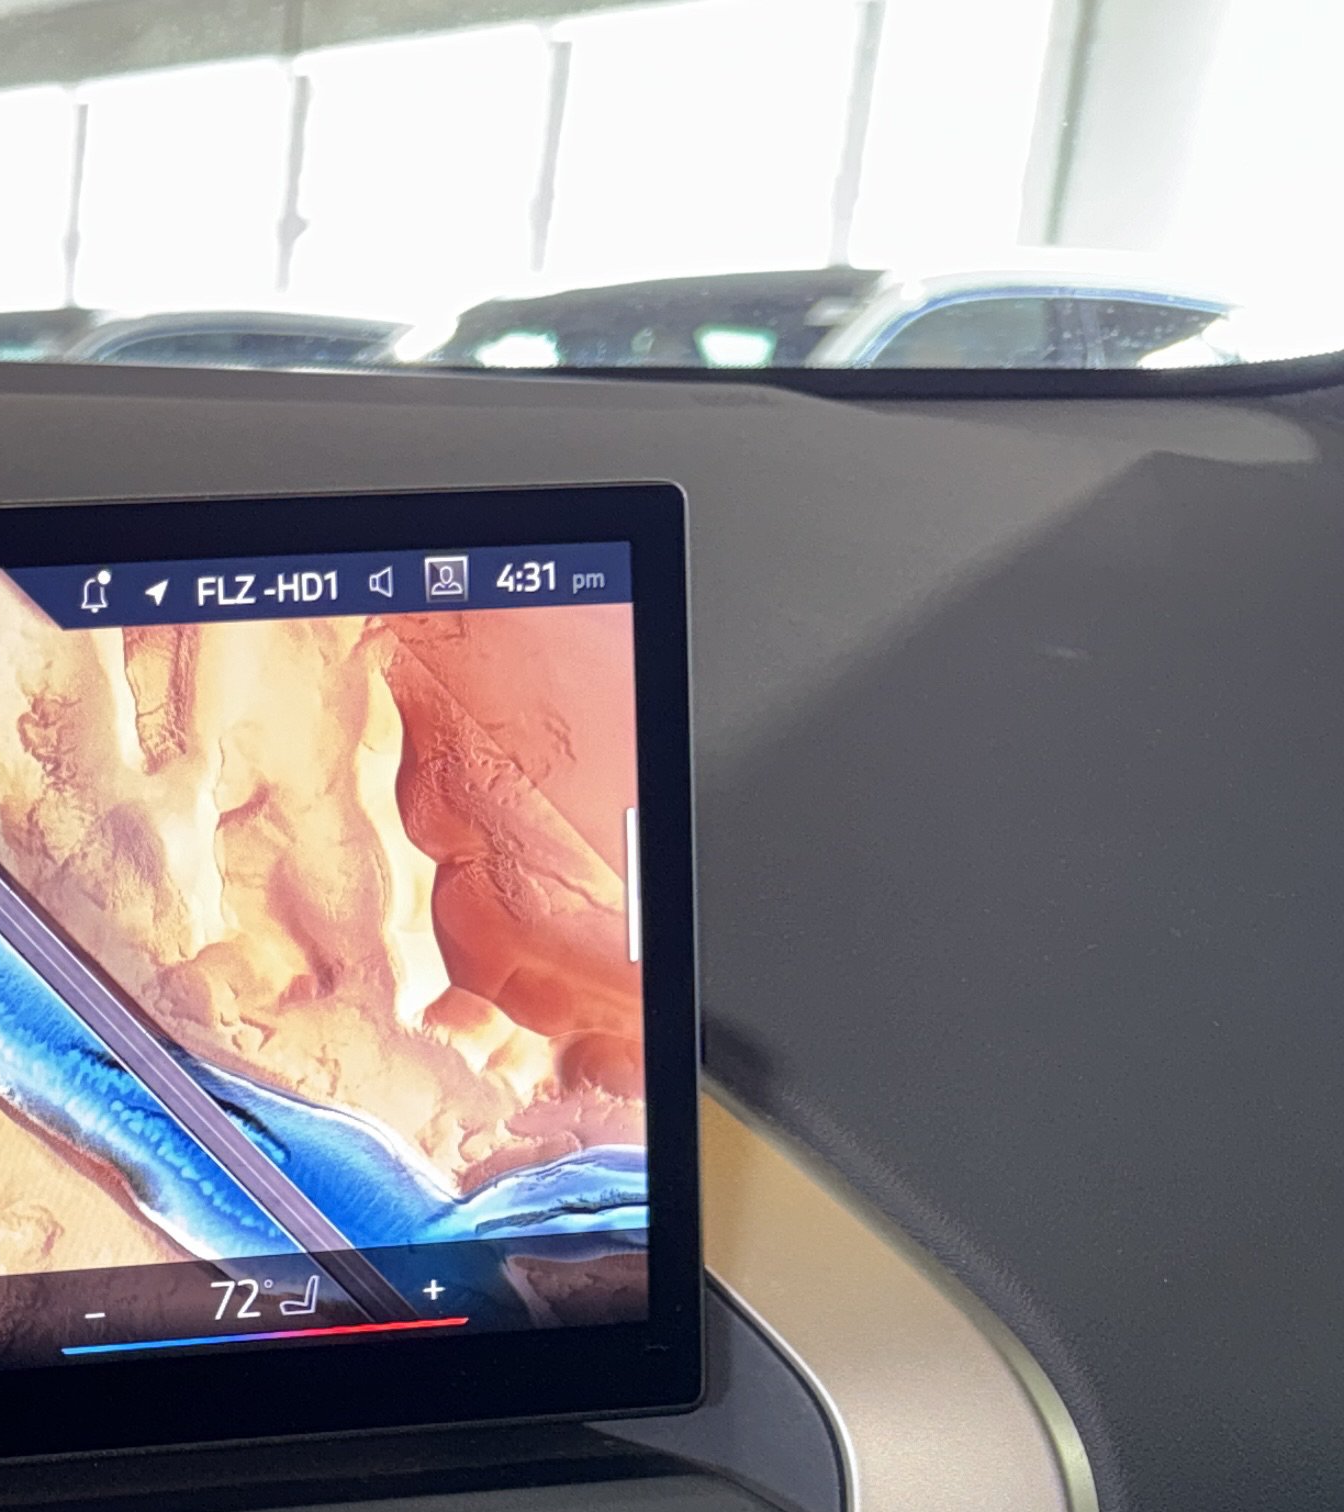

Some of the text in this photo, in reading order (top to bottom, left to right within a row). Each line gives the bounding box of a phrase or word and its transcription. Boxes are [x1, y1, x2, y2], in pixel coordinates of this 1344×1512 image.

[197, 570, 339, 606] FLZ -HD1
[496, 562, 606, 595] 4:31 pm
